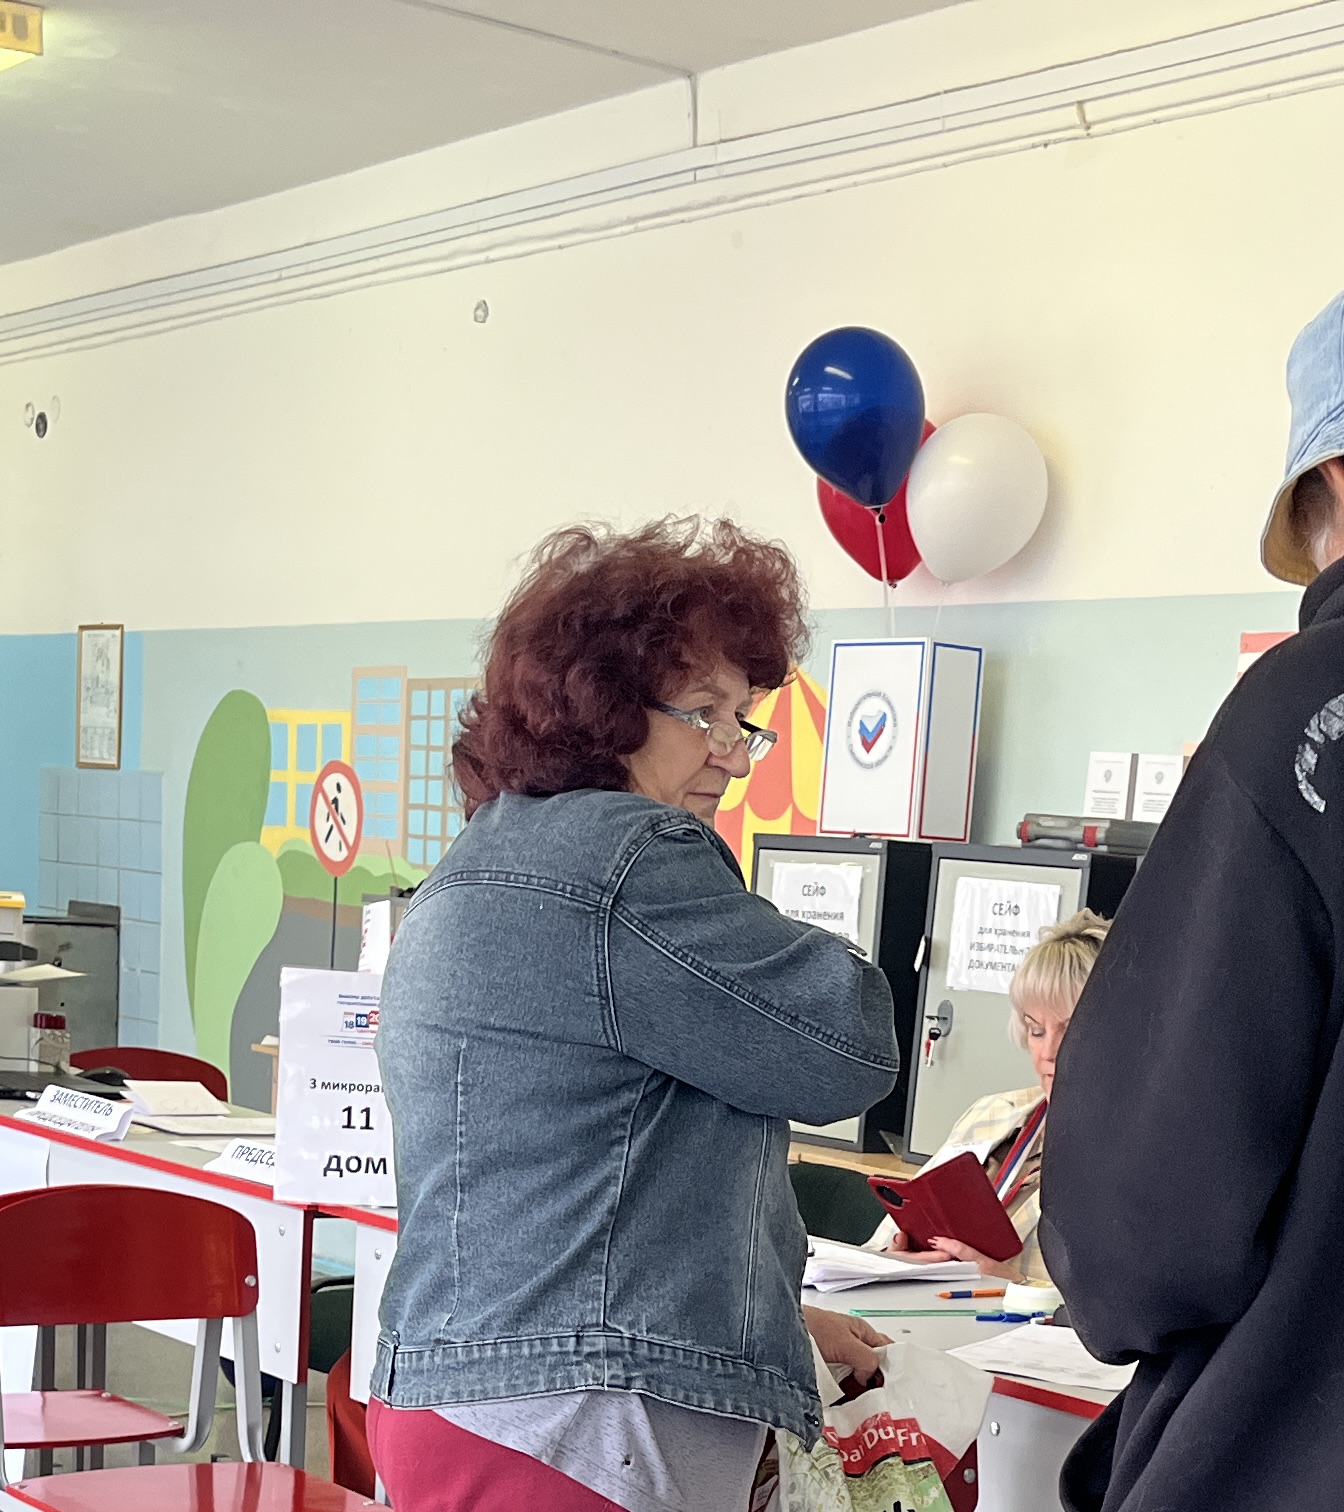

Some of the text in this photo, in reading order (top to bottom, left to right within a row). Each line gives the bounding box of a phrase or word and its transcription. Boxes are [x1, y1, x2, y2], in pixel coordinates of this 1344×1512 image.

[802, 882, 826, 897] СЕЙФ
[992, 901, 1020, 916] СЕЙФ
[309, 1078, 317, 1089] 3
[50, 1090, 113, 1117] ЗАМЕСТИТЕЛЬ
[341, 1105, 375, 1131] 11
